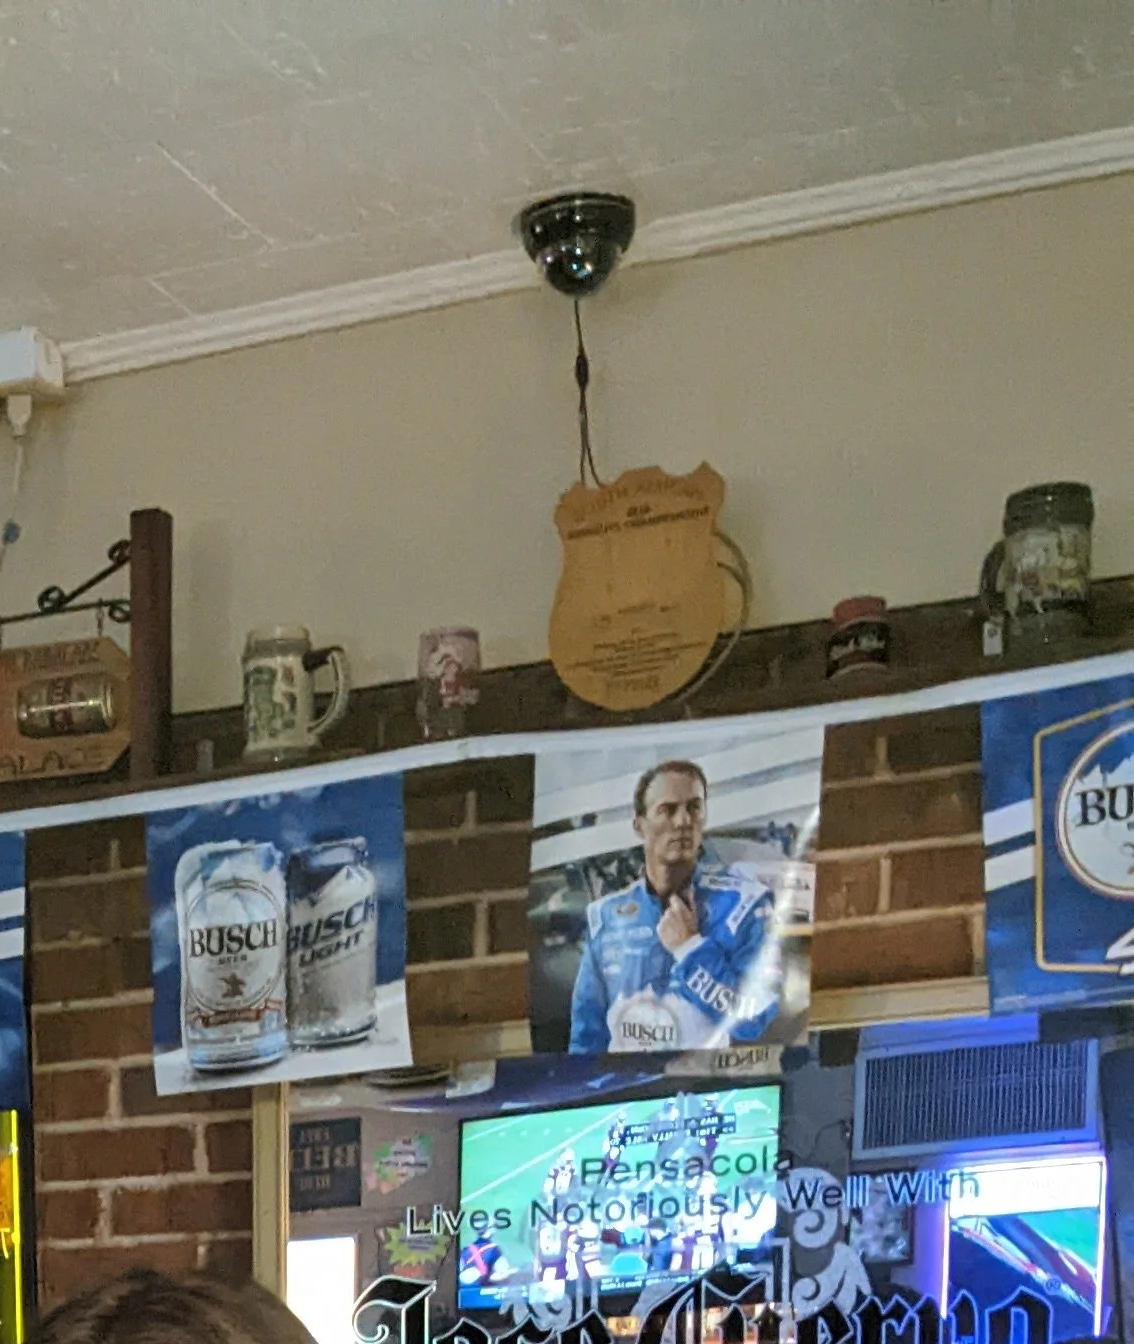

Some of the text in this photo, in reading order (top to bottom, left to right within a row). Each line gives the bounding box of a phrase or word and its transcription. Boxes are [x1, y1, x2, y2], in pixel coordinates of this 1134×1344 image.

[190, 919, 277, 957] BUSCH
[287, 895, 376, 952] BUSCH
[299, 930, 364, 967] LIGHT
[686, 965, 756, 1020] BUSH
[622, 1022, 674, 1042] BUSCH
[580, 1145, 795, 1185] Pensacola
[406, 1166, 980, 1237] Lives Notoriously Well With
